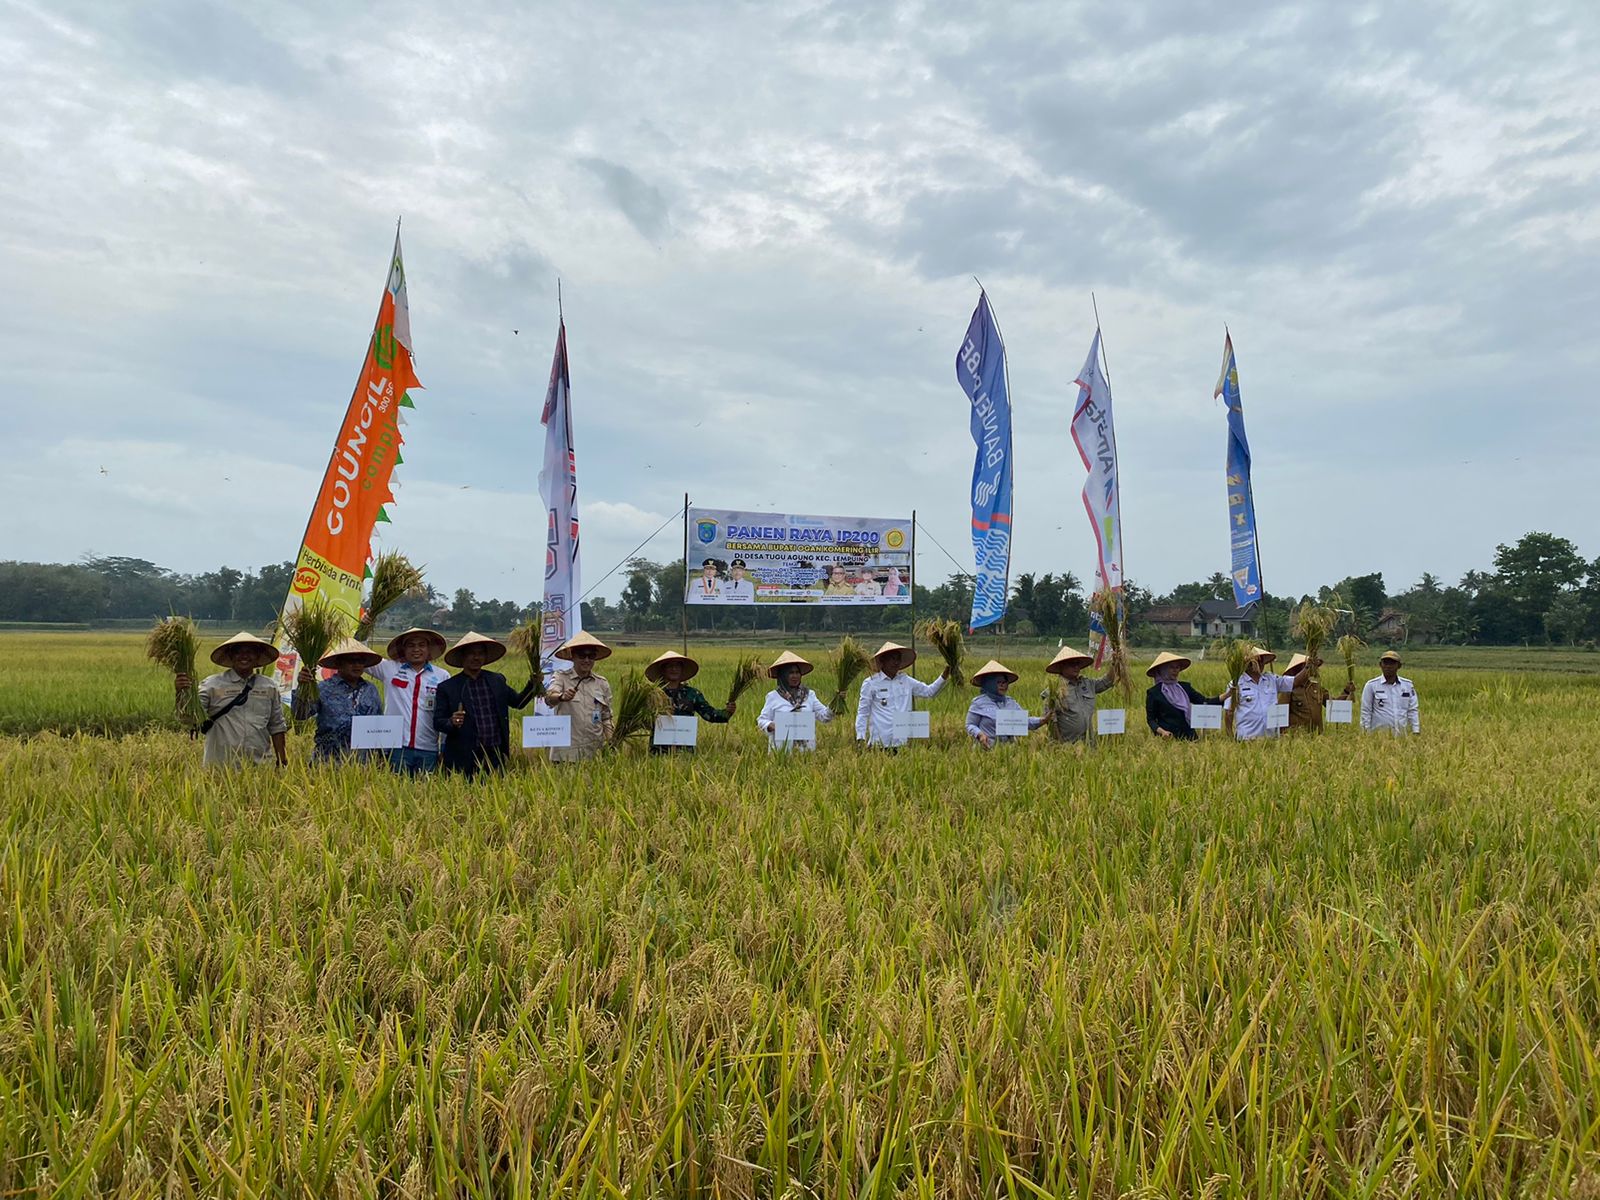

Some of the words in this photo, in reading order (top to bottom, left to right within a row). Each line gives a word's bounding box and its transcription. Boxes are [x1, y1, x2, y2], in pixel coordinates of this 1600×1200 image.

[378, 395, 391, 413] 300
[327, 376, 388, 535] COUNCIL
[726, 525, 787, 541] PANEN
[789, 527, 833, 542] RAYA
[836, 530, 880, 545] IP200
[726, 541, 767, 551] BERSAMA
[768, 543, 796, 552] BUPATI
[797, 544, 822, 552] OGAN
[823, 545, 864, 554] KOMERING
